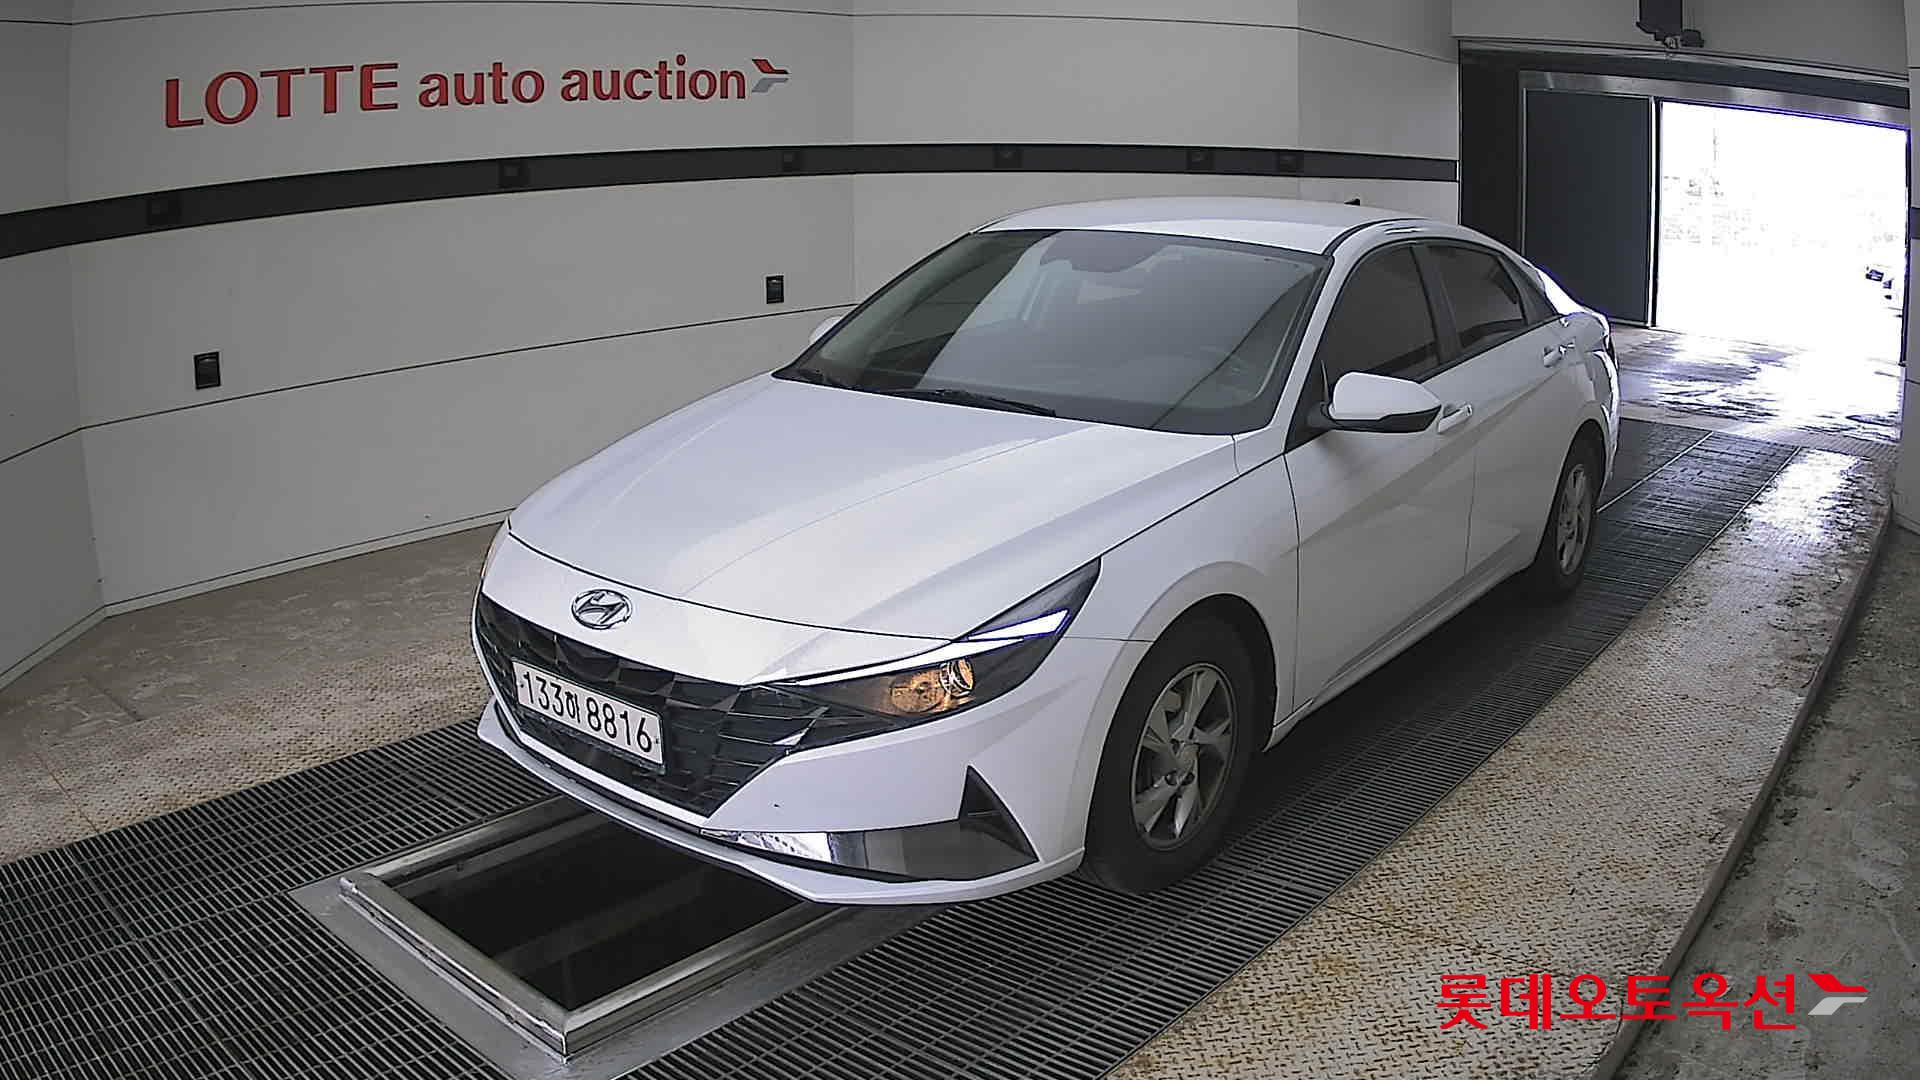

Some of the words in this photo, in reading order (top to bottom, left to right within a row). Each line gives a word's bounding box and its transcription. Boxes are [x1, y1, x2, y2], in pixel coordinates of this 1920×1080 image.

[165, 63, 399, 129] LOTTE
[418, 61, 546, 108] auto
[560, 54, 747, 103] auction
